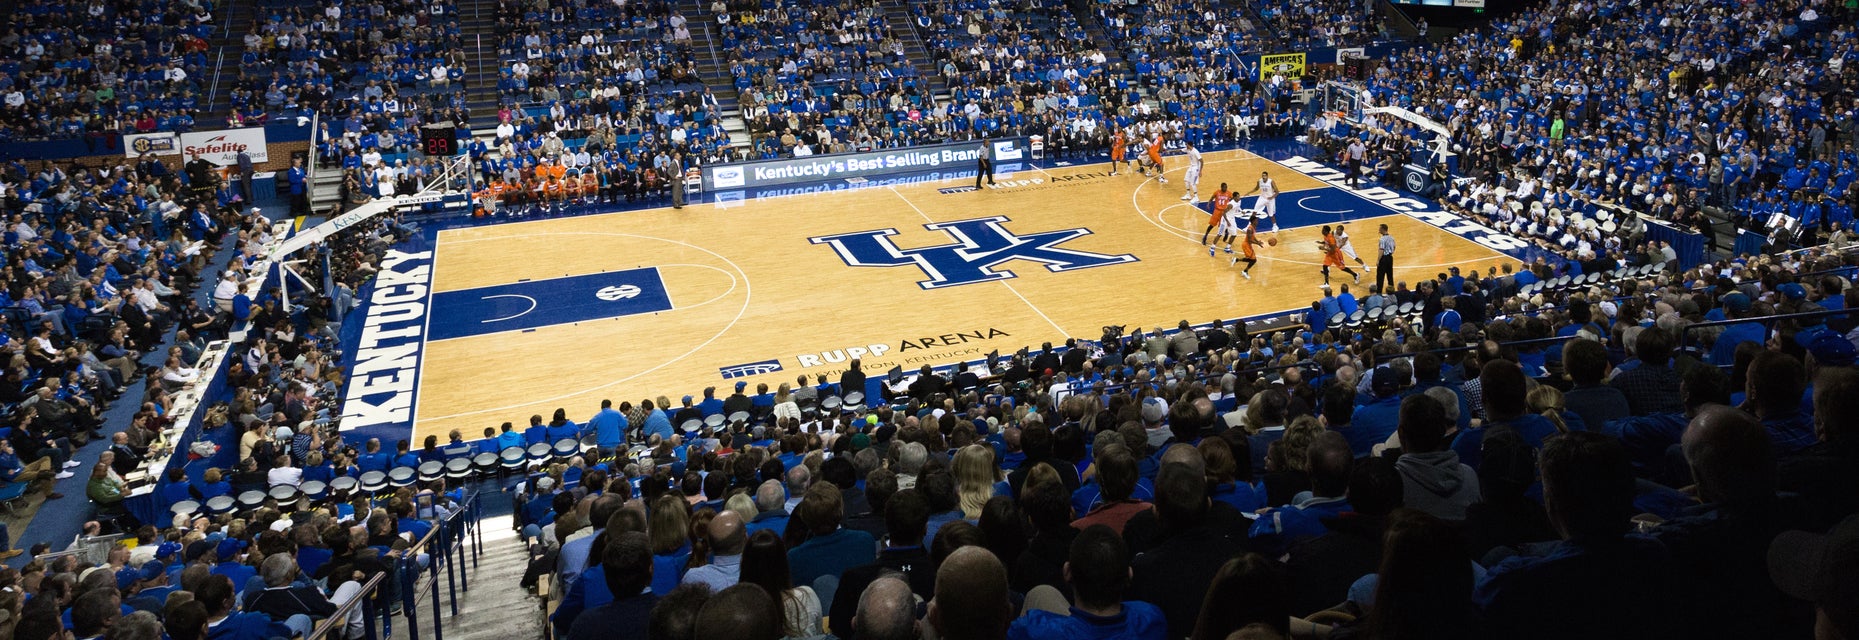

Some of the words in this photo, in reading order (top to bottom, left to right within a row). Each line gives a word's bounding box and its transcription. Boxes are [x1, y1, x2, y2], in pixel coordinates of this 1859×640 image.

[1264, 55, 1303, 66] AMERICA'S
[185, 142, 247, 156] Safelite
[429, 138, 449, 154] 29
[755, 160, 844, 180] Kentucky's
[847, 157, 883, 172] Best
[886, 152, 939, 168] Selling
[398, 196, 443, 204] KENTUCKY
[1276, 155, 1529, 250] WILDCATS
[807, 215, 1139, 290] UK
[338, 249, 432, 431] KENTUCKY
[796, 343, 890, 368] RUPP
[900, 328, 1011, 352] ARENA
[905, 347, 980, 364] KENTUCKY
